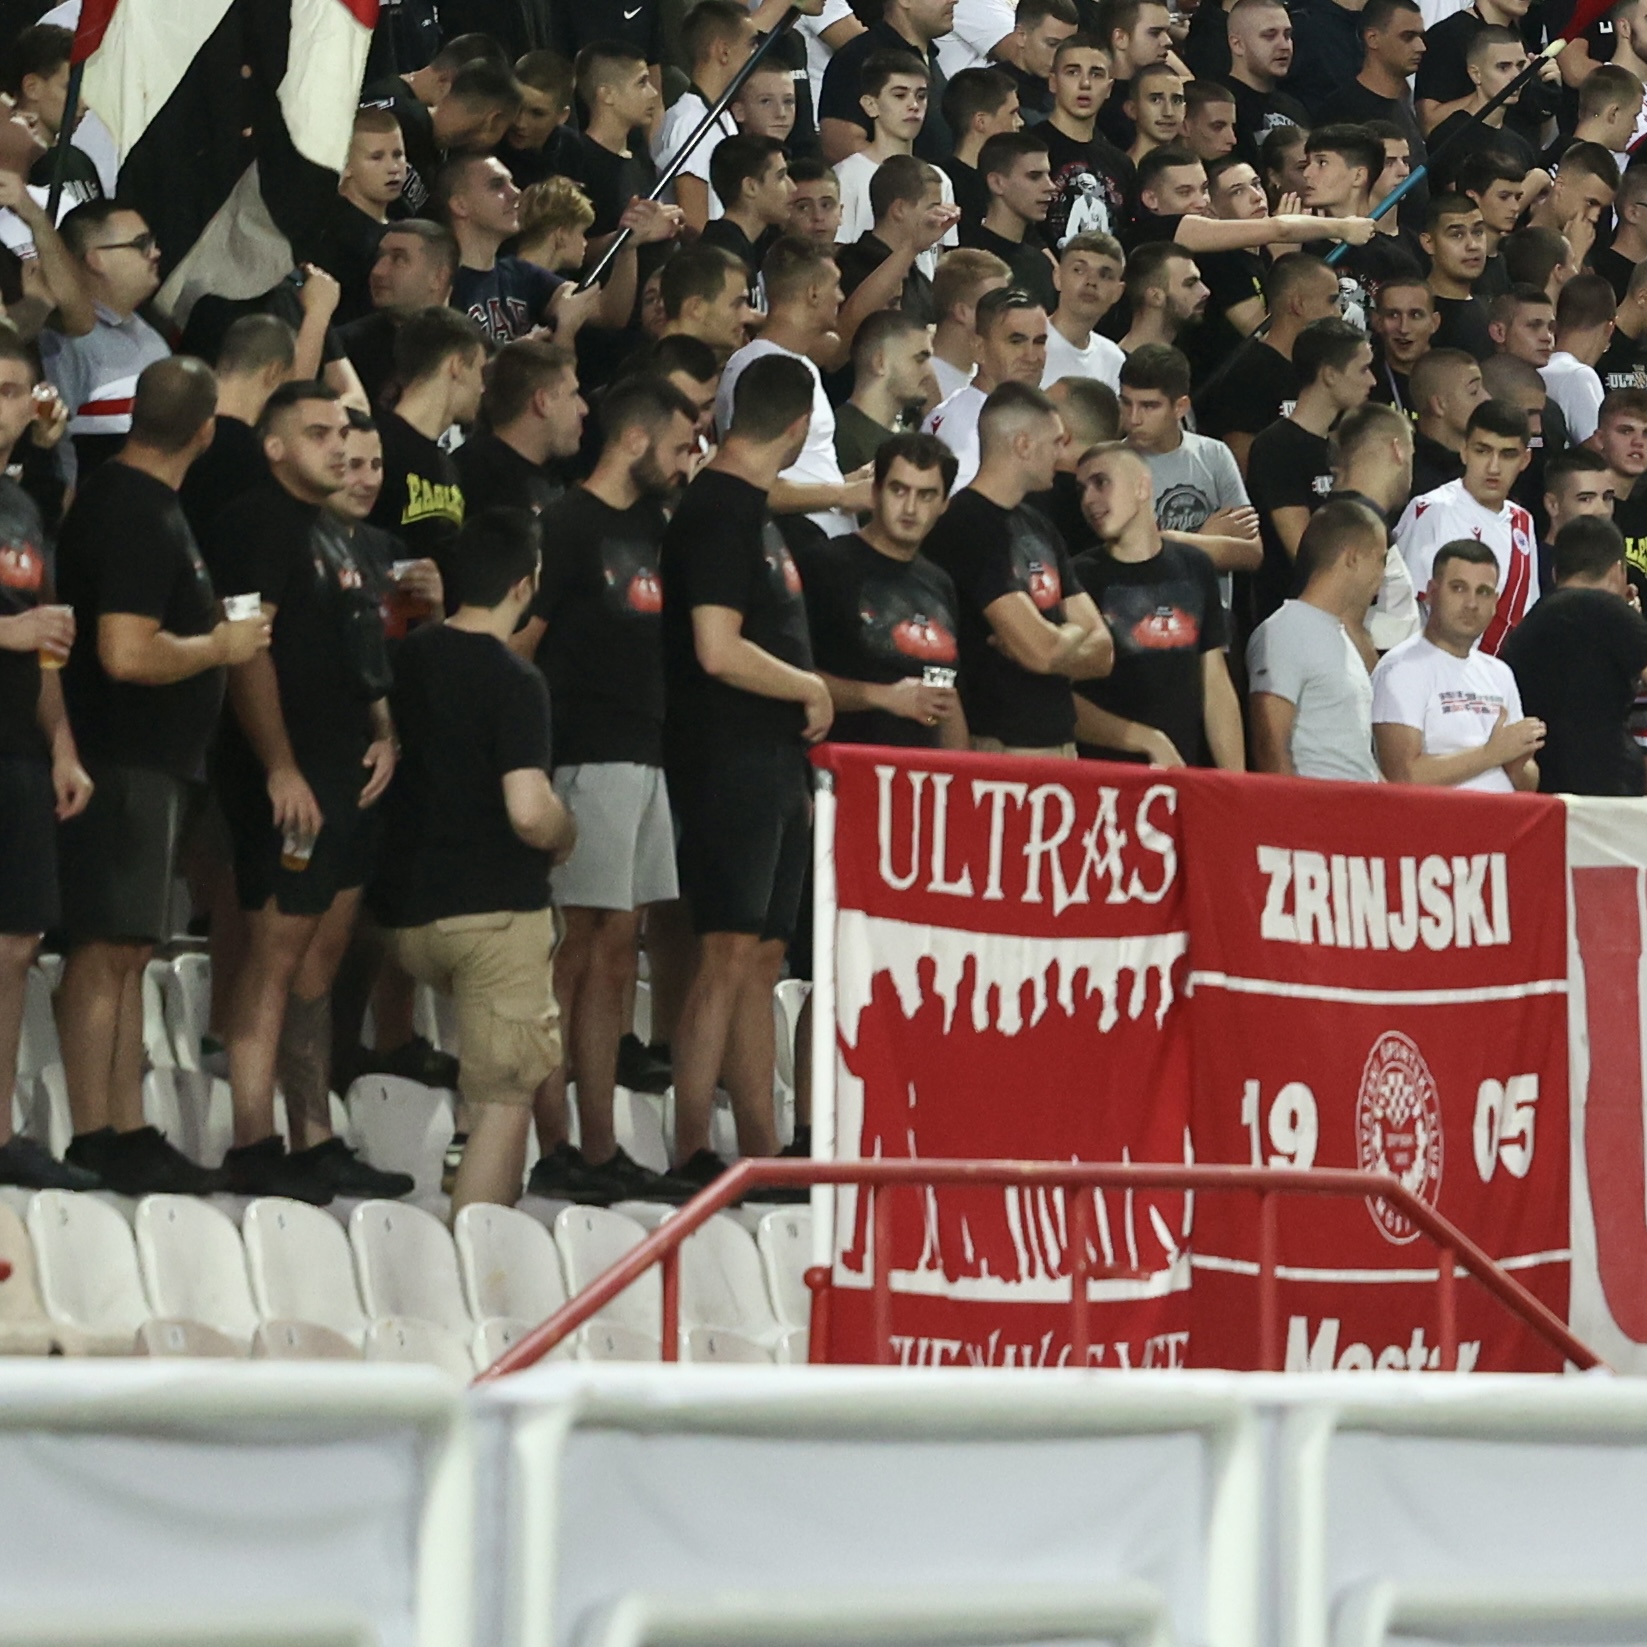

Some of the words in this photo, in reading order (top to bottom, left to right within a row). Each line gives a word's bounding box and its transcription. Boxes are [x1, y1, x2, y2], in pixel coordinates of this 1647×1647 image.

[875, 765, 1179, 915] ULTRAS
[1256, 845, 1511, 951] ZRINJSKI
[1242, 1080, 1318, 1171] 19
[1473, 1073, 1539, 1182] 05
